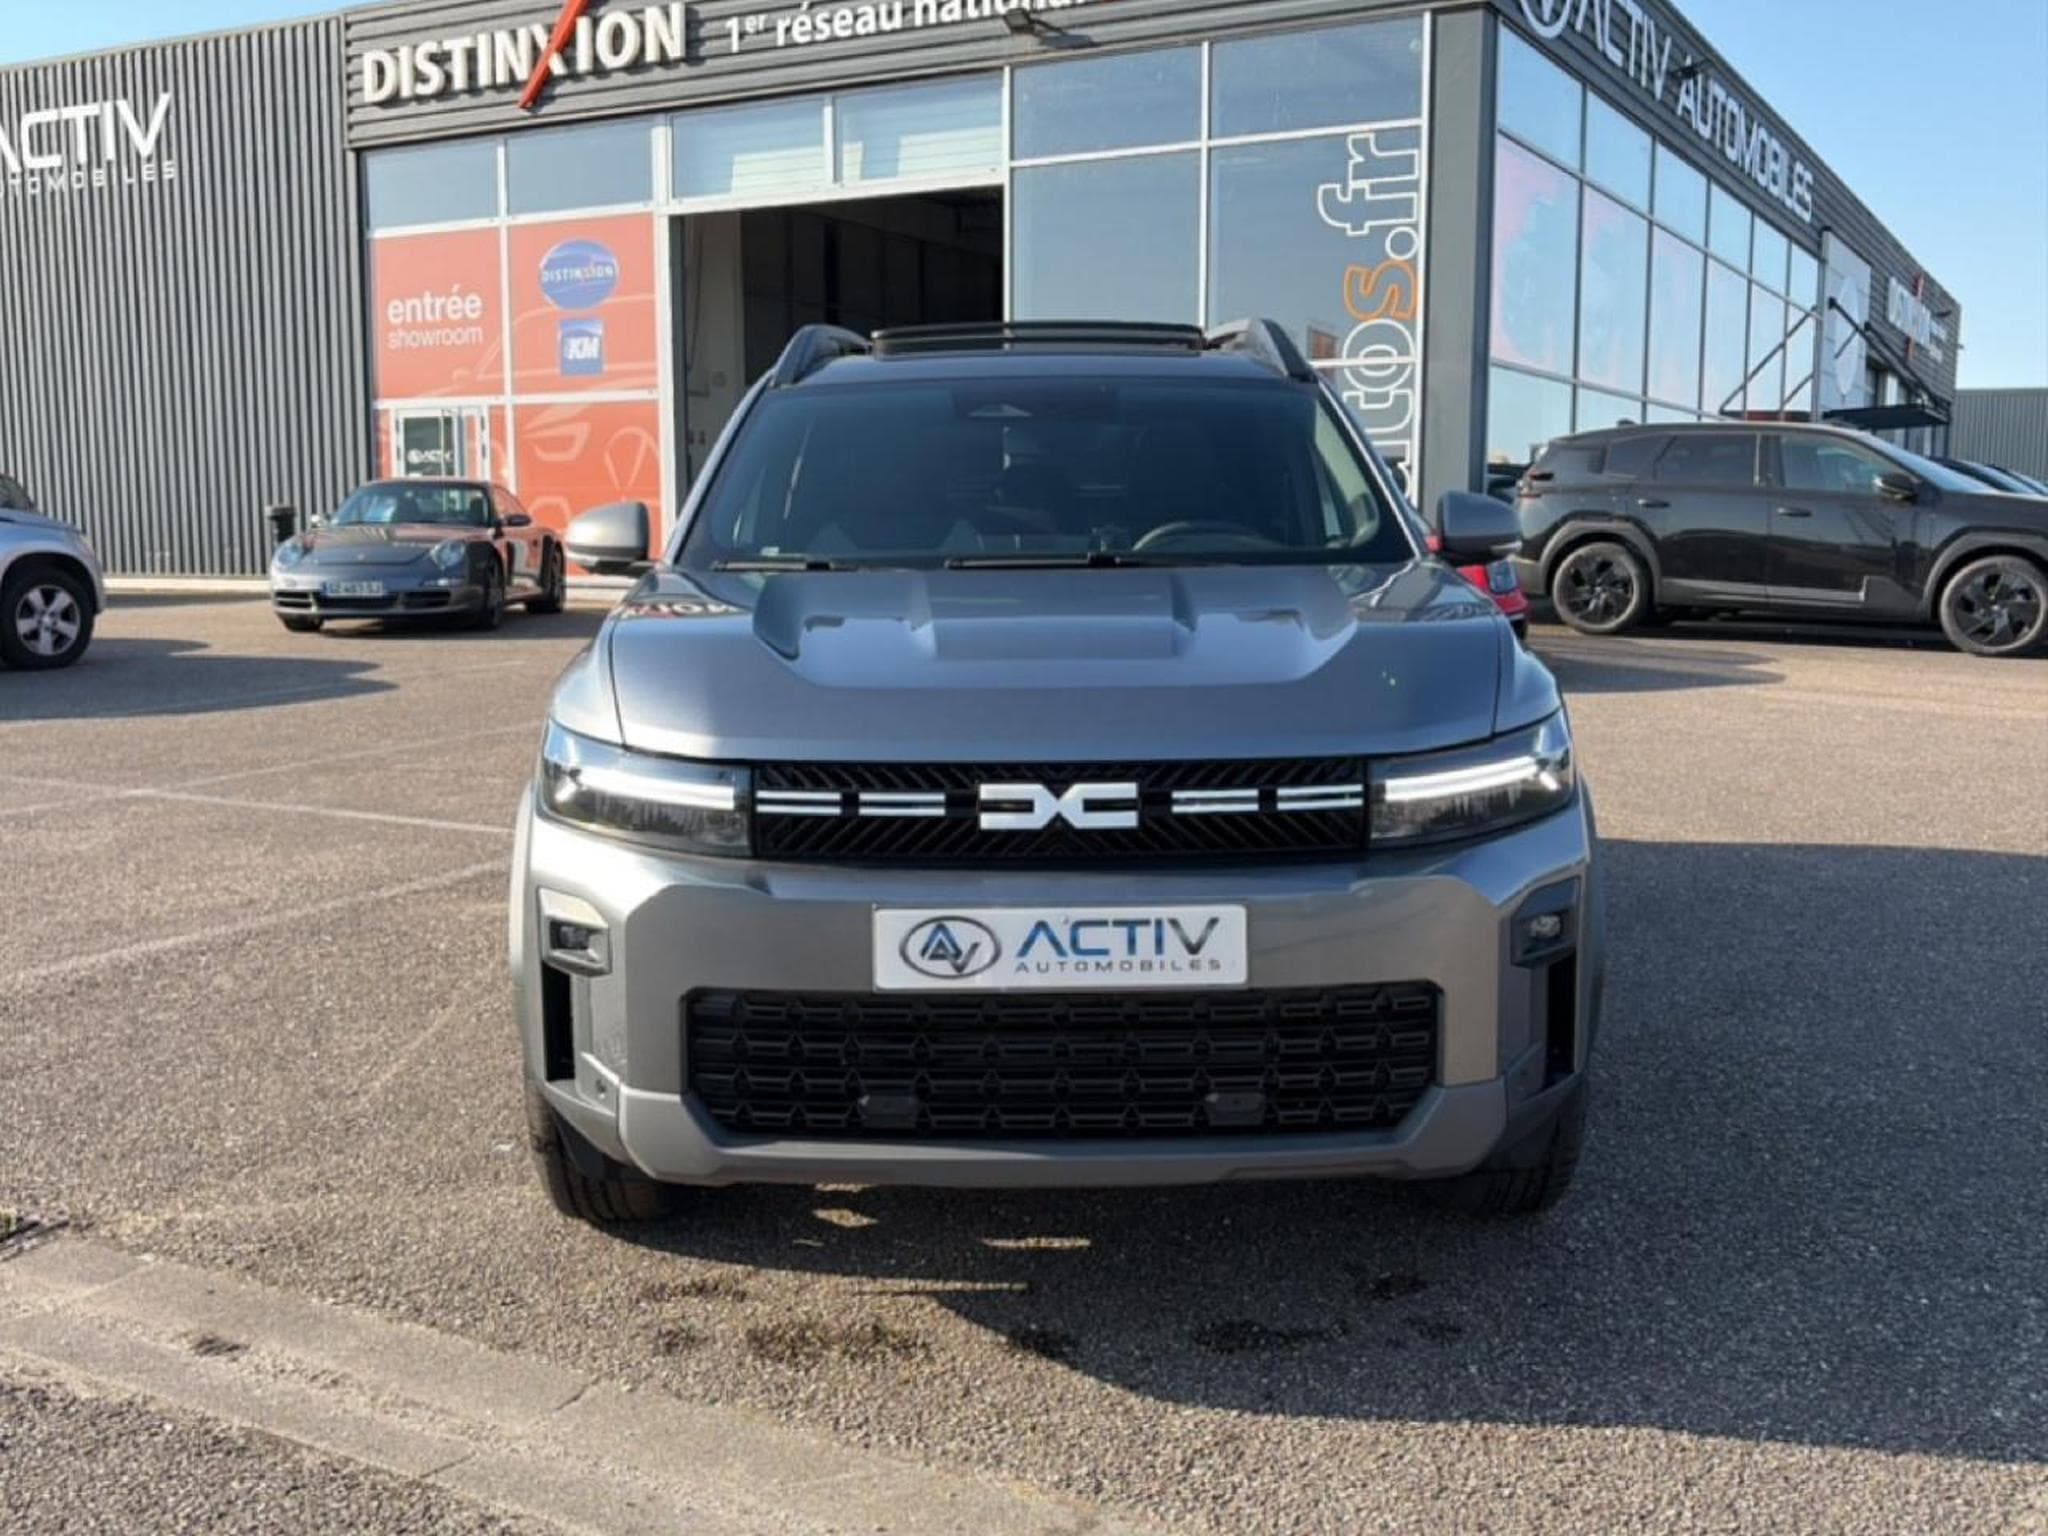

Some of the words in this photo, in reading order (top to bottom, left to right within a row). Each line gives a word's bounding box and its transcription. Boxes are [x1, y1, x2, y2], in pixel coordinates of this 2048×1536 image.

[775, 3, 902, 47] réseau
[362, 0, 690, 108] DISTINXION
[1677, 54, 1814, 223] AUTOMOBILES
[0, 159, 175, 199] TOMOBILES
[387, 284, 483, 325] entrée
[387, 325, 484, 349] showroom
[1015, 916, 1221, 959] ACTIV
[1014, 958, 1223, 974] AUTOMOBILES
